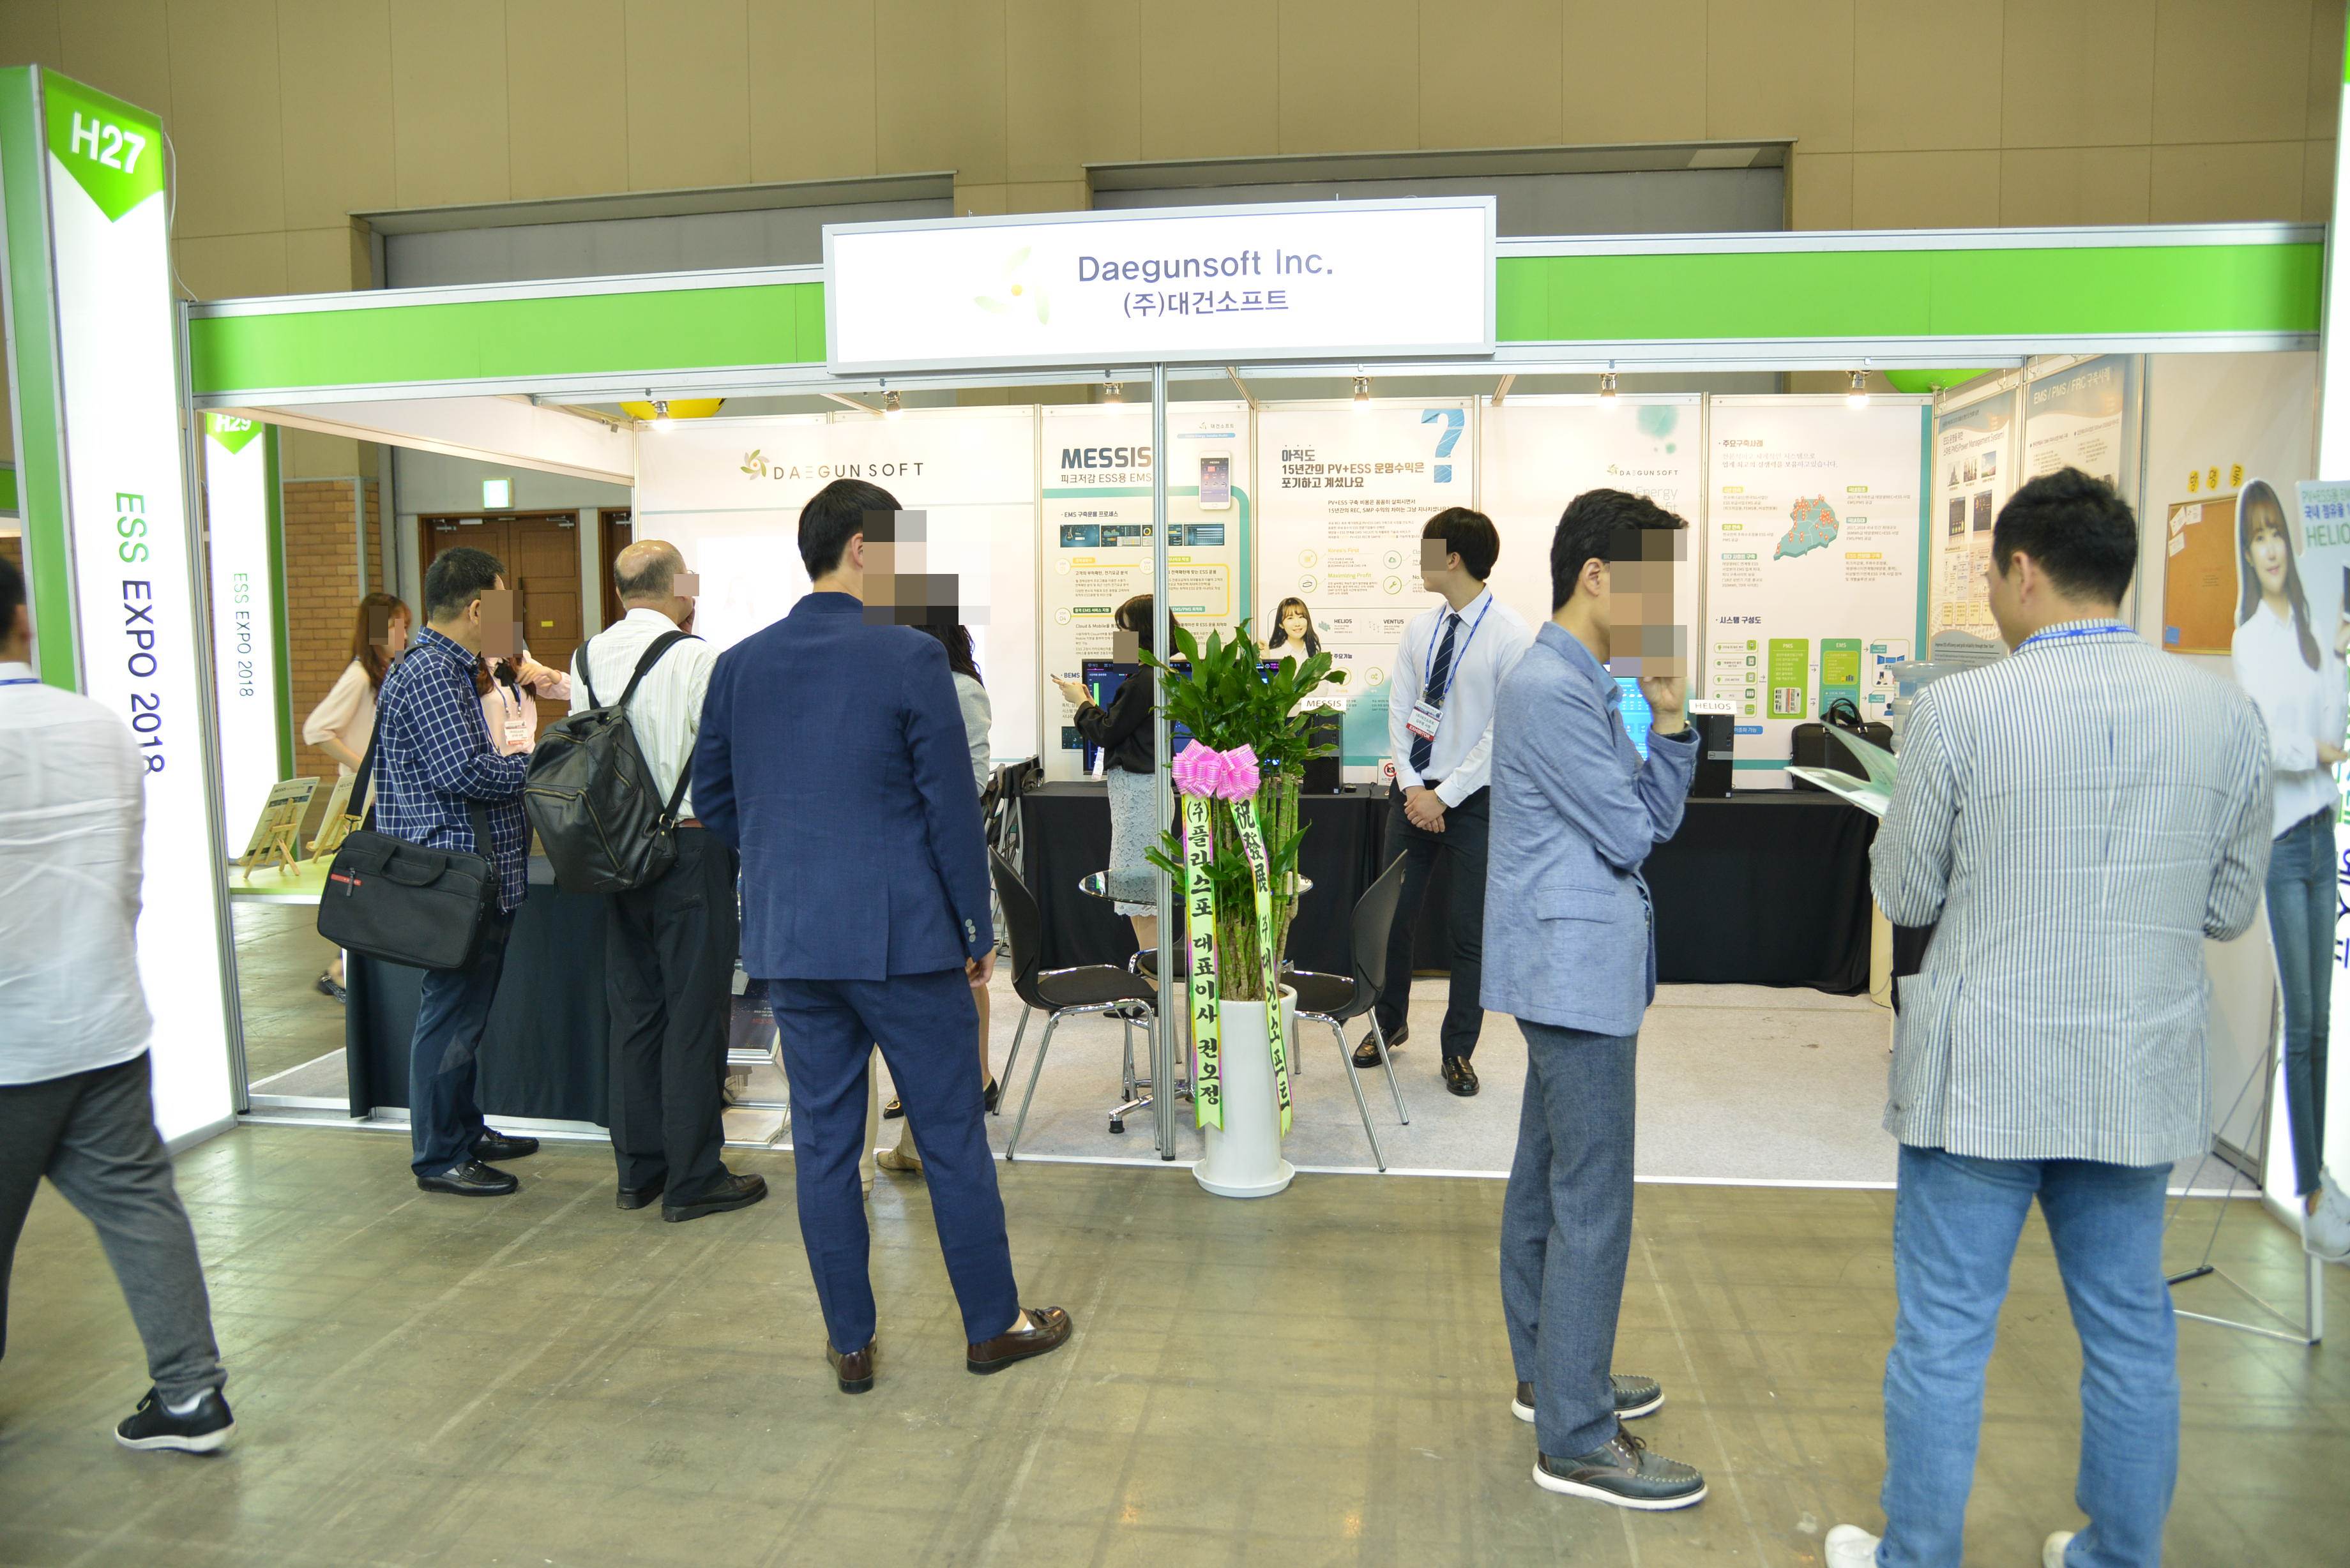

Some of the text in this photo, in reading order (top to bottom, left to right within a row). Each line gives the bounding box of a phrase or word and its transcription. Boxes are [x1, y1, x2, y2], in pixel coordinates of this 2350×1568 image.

[72, 111, 146, 174] H27
[1078, 248, 1335, 283] Daegunsoft Inc.
[1123, 289, 1290, 320] (주)대건소프트
[2034, 389, 2047, 404] EMS
[2052, 382, 2066, 398] PMS
[215, 412, 252, 433] H29
[1061, 446, 1152, 469] MESSIS
[1282, 449, 1315, 462] 아직도
[774, 462, 924, 480] DAEGUN SOFT
[1061, 472, 1152, 484] 피크저감 ESS용 EMS
[1282, 464, 1324, 475] 15년간의
[1328, 464, 1371, 474] PV+ESS
[1282, 476, 1364, 488] 포기하고 계셨나요
[116, 492, 165, 776] ESS EXPO 2018
[234, 573, 254, 697] ESS EXPO 2018
[1409, 725, 1430, 739] EXHIBITOR
[1192, 933, 1218, 1024] 대표이사
